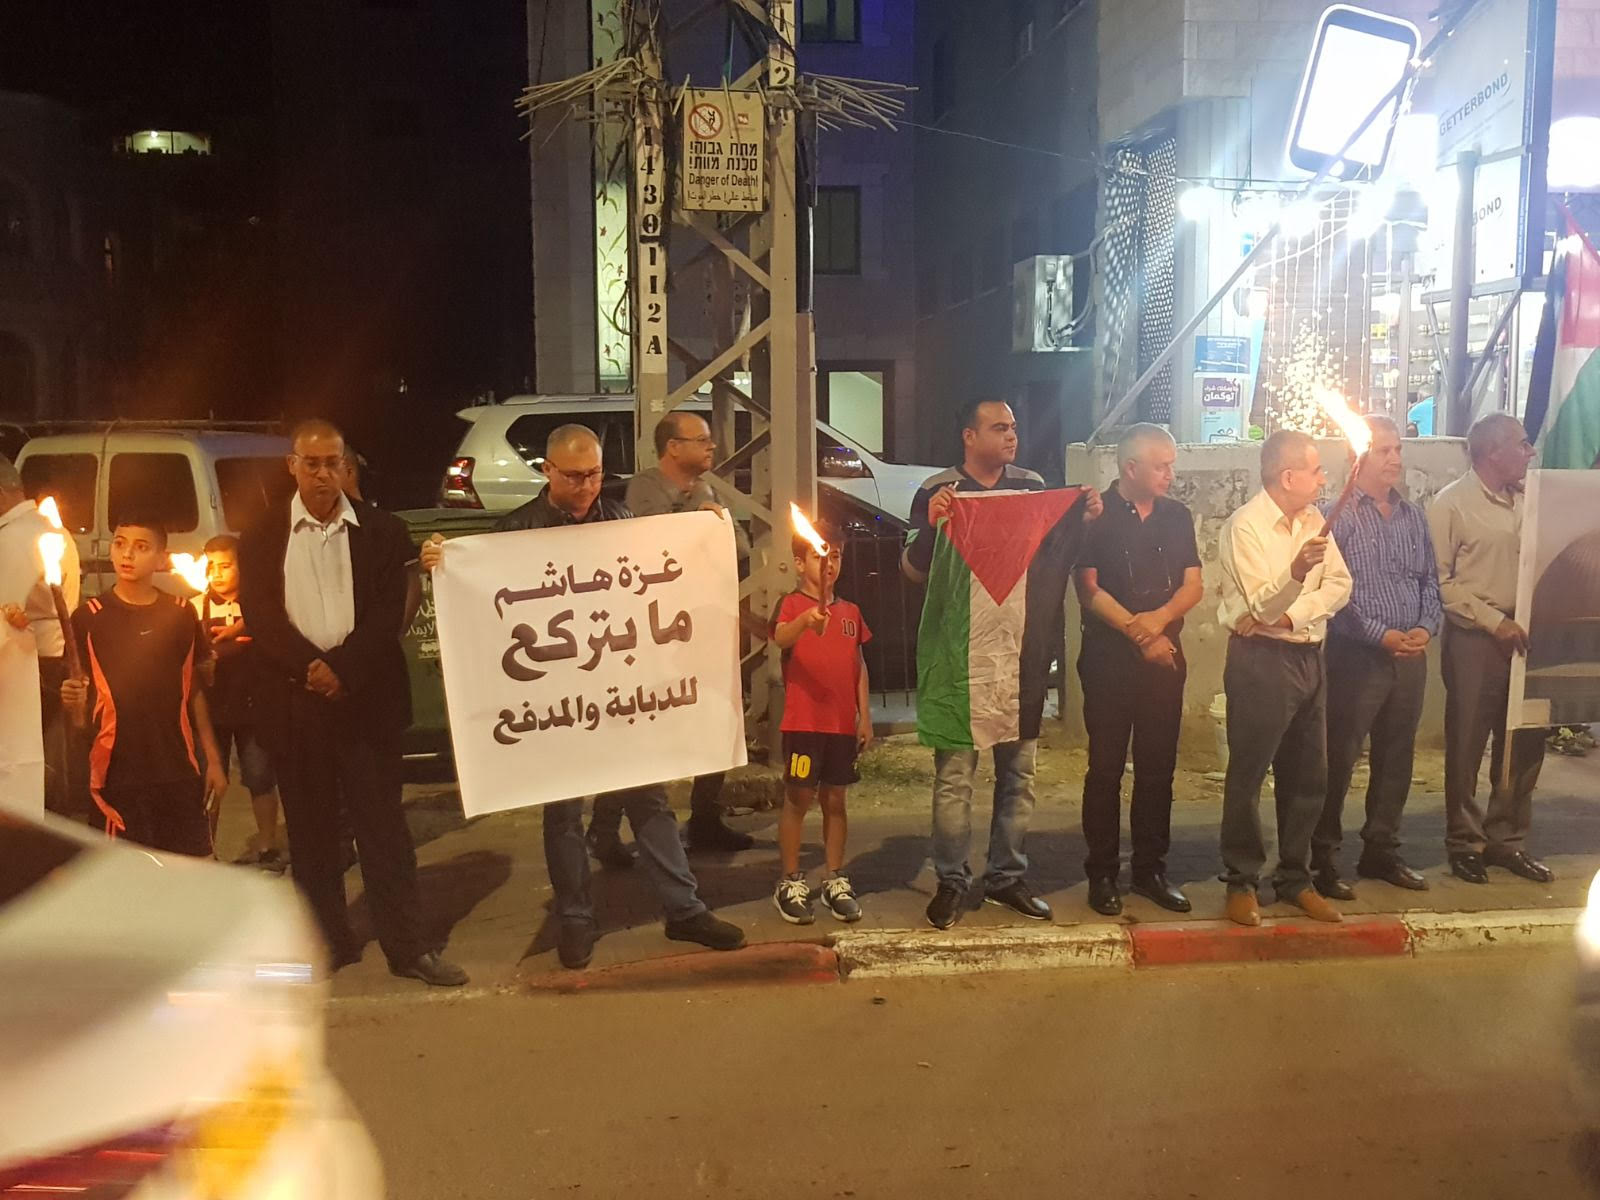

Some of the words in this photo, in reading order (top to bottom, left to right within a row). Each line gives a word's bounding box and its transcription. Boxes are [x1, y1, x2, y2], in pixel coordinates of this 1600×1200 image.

[1439, 71, 1509, 137] GETTERBOND
[726, 157, 758, 171] סכנת
[730, 142, 758, 156] מתח
[688, 173, 720, 188] Danger
[720, 174, 730, 186] of
[494, 561, 613, 620] هاشم
[618, 550, 683, 596] غزة
[501, 608, 638, 682] بتركع
[648, 599, 693, 646] ما
[841, 617, 857, 638] 10
[493, 694, 600, 745] والمدفع
[605, 675, 698, 725] للدبابة
[790, 752, 812, 779] 10
